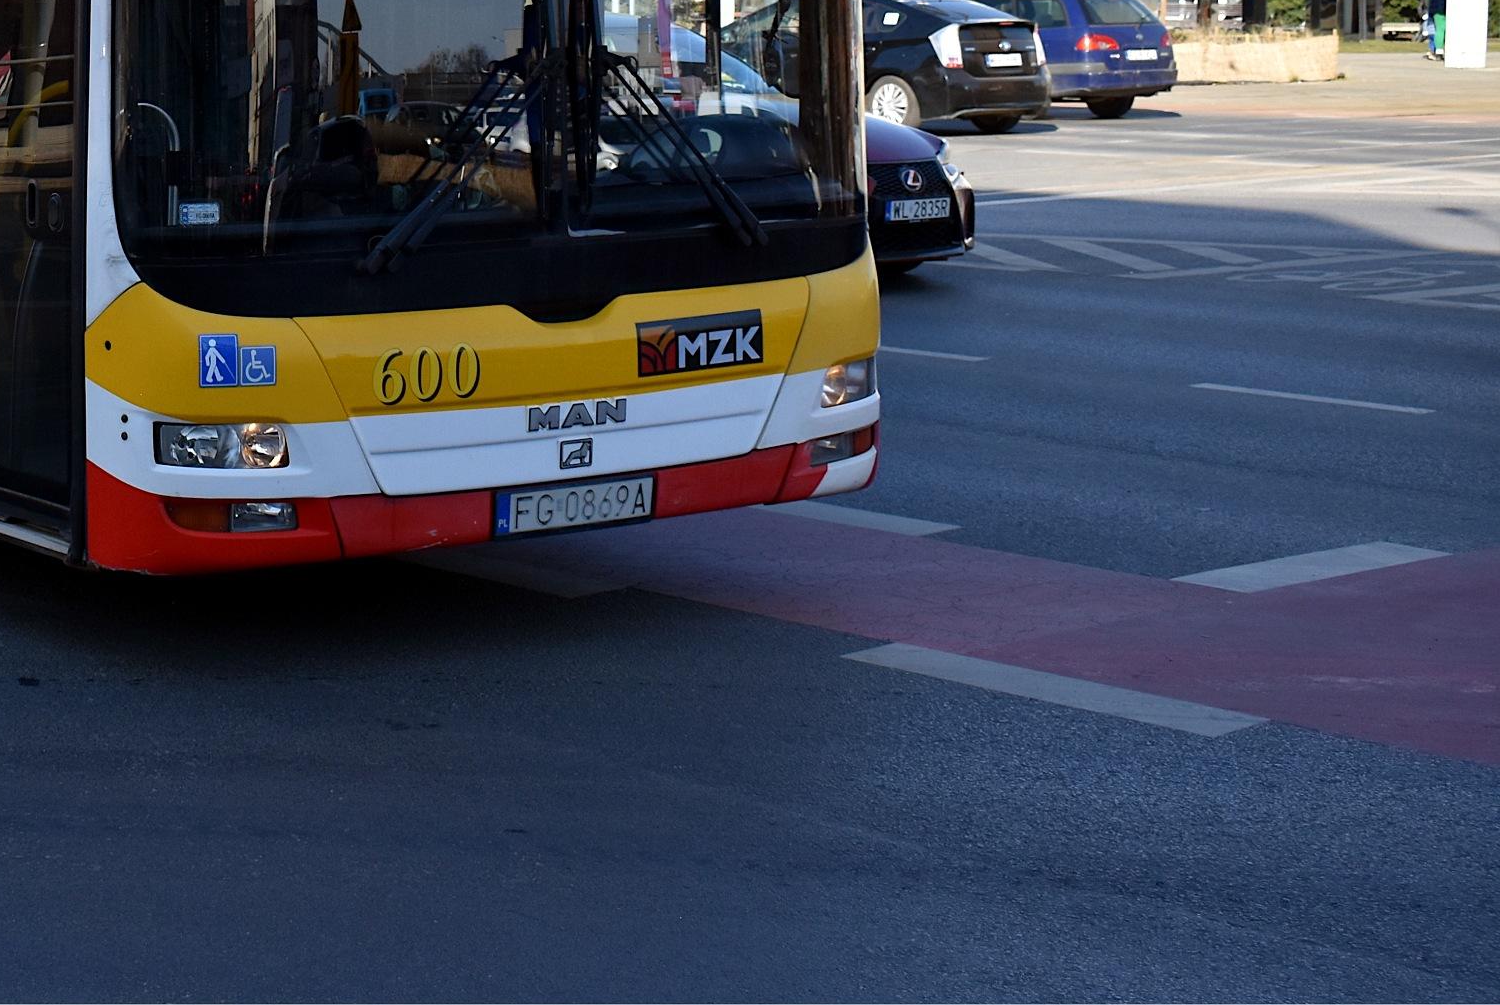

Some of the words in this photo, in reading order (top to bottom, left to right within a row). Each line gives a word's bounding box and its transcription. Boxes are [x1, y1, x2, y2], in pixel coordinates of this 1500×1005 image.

[893, 202, 909, 219] WL
[913, 199, 949, 218] 2835R
[676, 324, 761, 369] MZK
[373, 342, 481, 406] 600
[527, 398, 627, 433] MAN
[497, 518, 509, 529] PL
[515, 493, 555, 529] FG
[564, 482, 647, 522] 0869A
